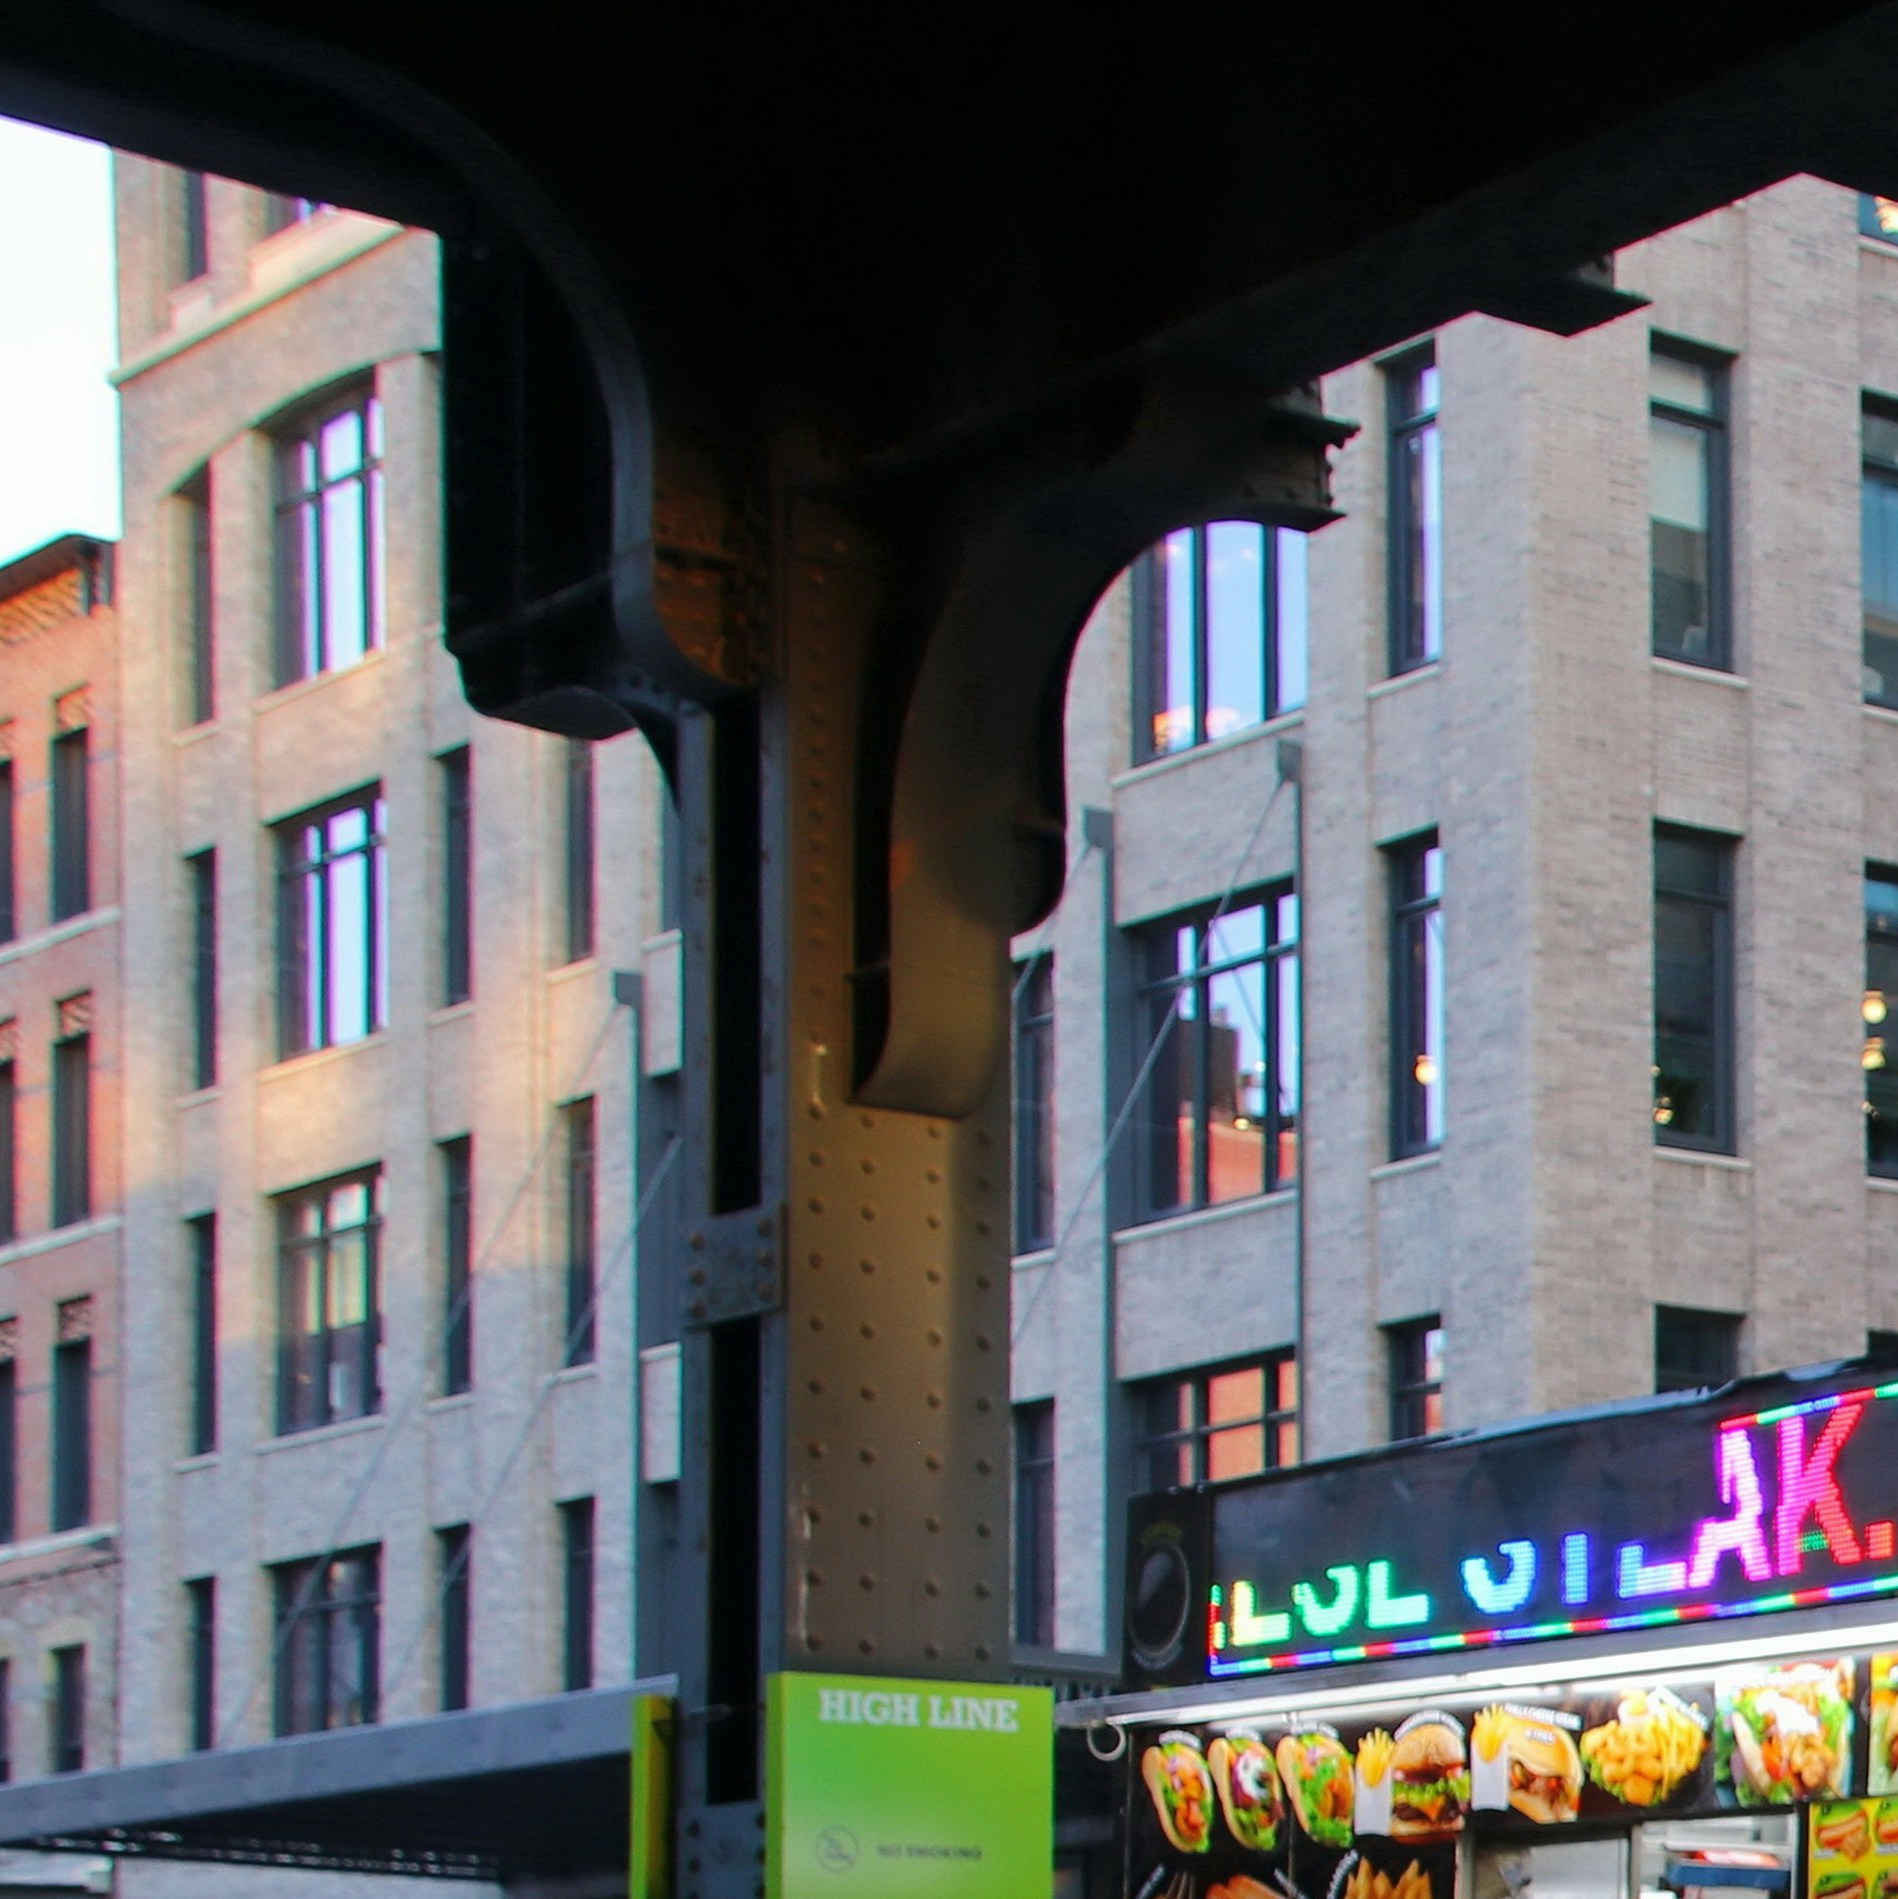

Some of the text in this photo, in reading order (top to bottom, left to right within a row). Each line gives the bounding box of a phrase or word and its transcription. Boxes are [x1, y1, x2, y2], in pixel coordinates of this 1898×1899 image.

[818, 1690, 1018, 1733] HIGH LINE
[877, 1844, 901, 1859] NO
